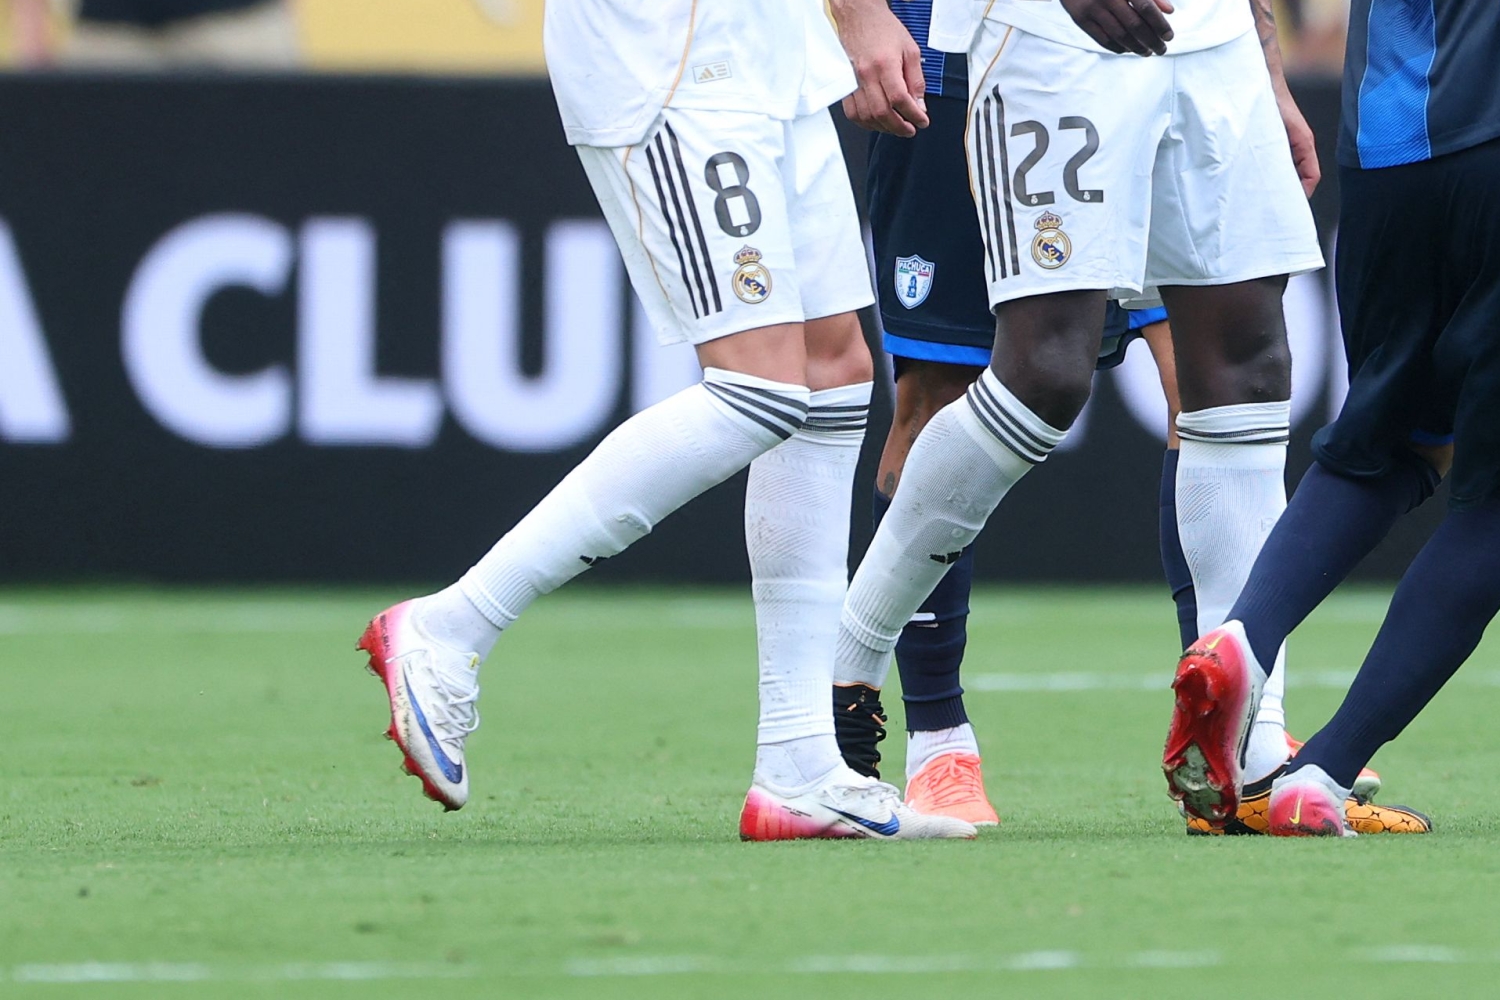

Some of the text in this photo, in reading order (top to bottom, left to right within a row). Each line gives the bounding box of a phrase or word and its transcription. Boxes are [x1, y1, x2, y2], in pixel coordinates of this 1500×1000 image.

[705, 151, 763, 238] 8
[1010, 115, 1105, 208] 22
[899, 259, 930, 274] PACHUCA
